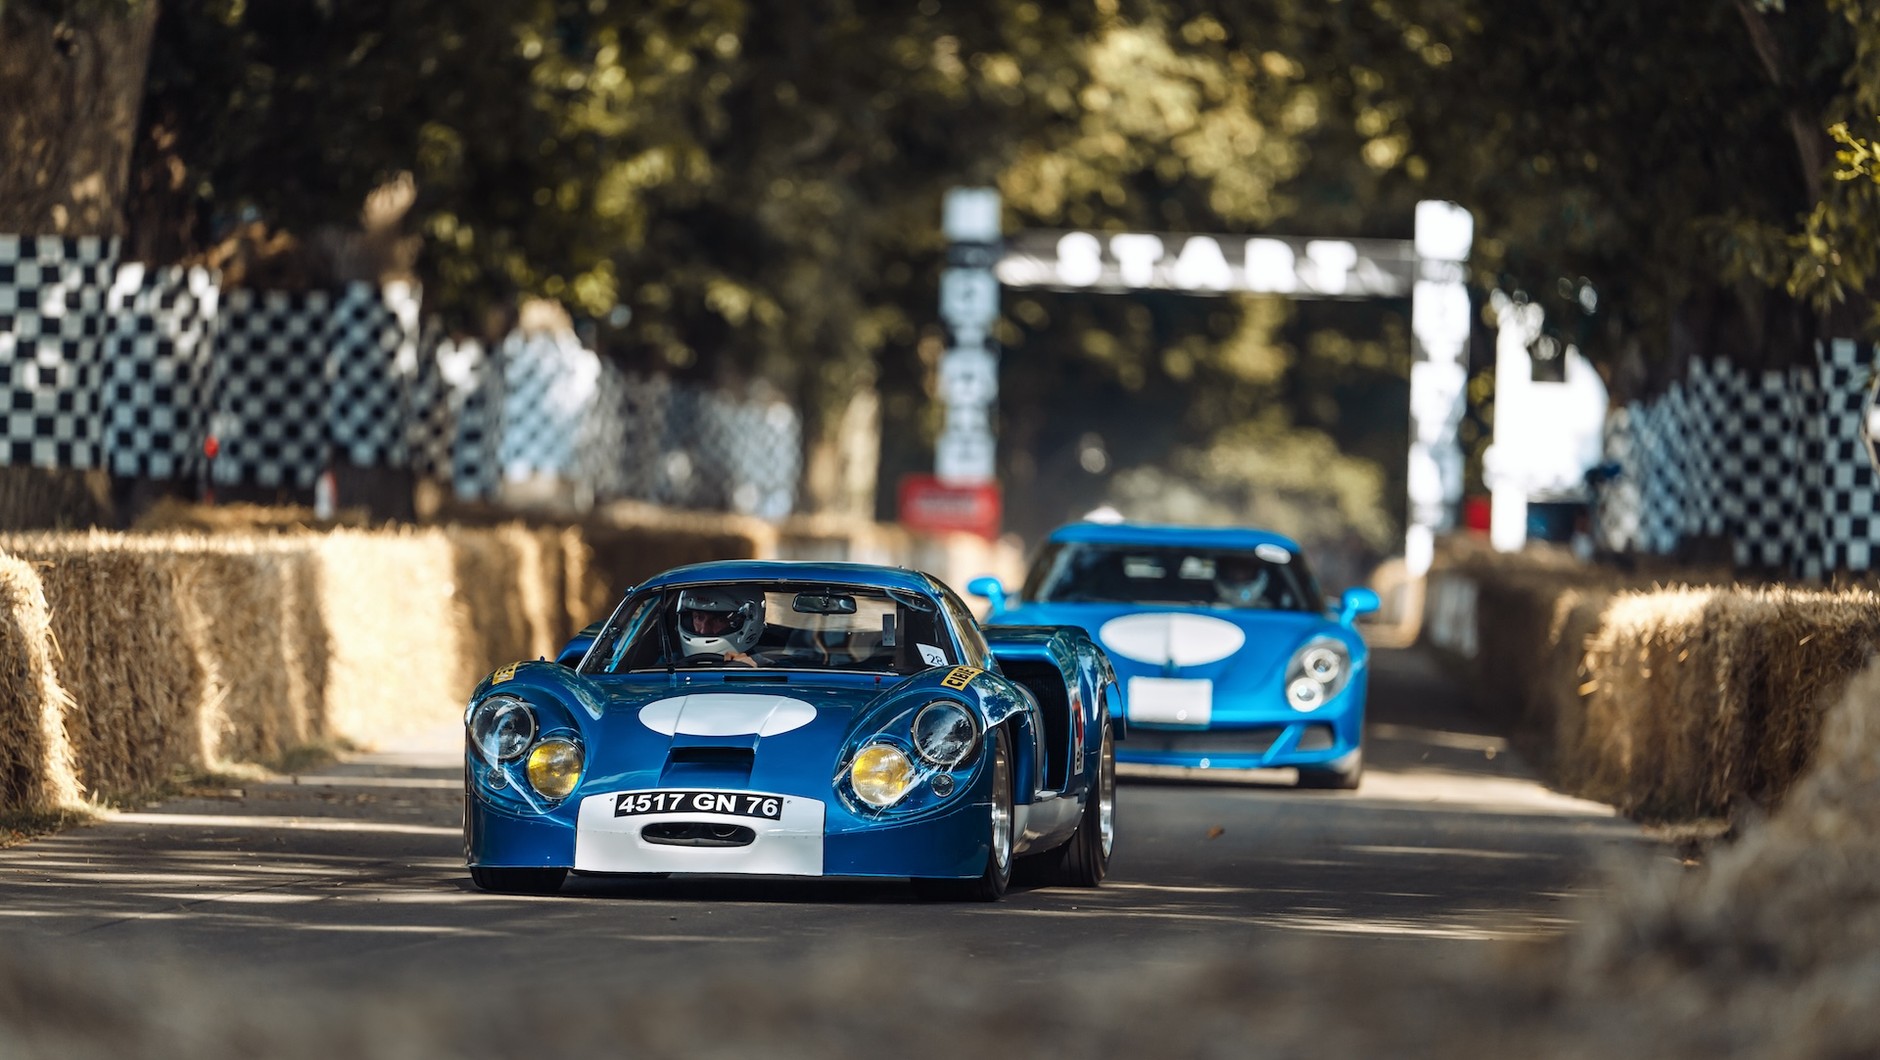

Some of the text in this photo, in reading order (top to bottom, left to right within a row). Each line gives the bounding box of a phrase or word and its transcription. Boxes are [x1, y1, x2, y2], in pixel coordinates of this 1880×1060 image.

[1056, 231, 1357, 294] START
[926, 653, 945, 667] 28
[618, 793, 779, 816] 4517 GN 76
